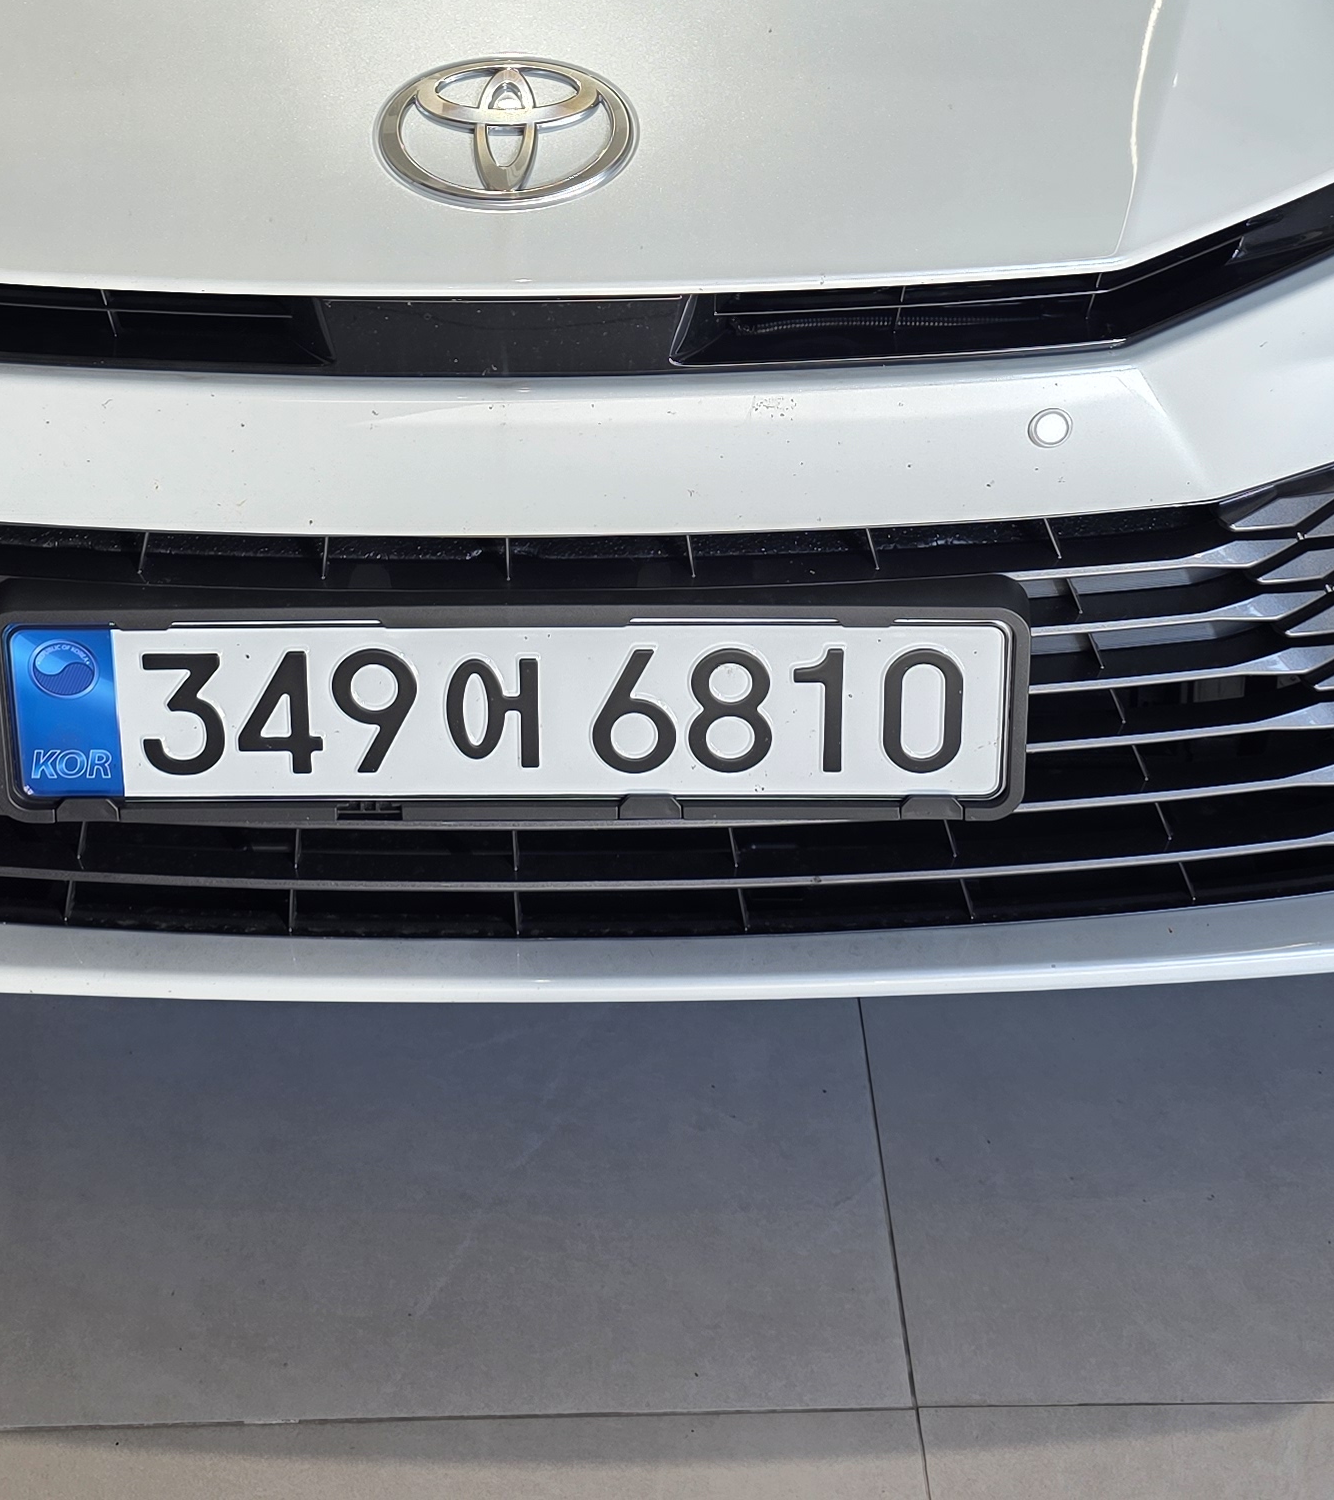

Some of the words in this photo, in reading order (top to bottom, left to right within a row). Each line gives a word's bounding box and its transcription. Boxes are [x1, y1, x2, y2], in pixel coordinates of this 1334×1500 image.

[142, 648, 541, 776] 349어
[592, 647, 965, 774] 6810
[31, 749, 113, 779] KOR
